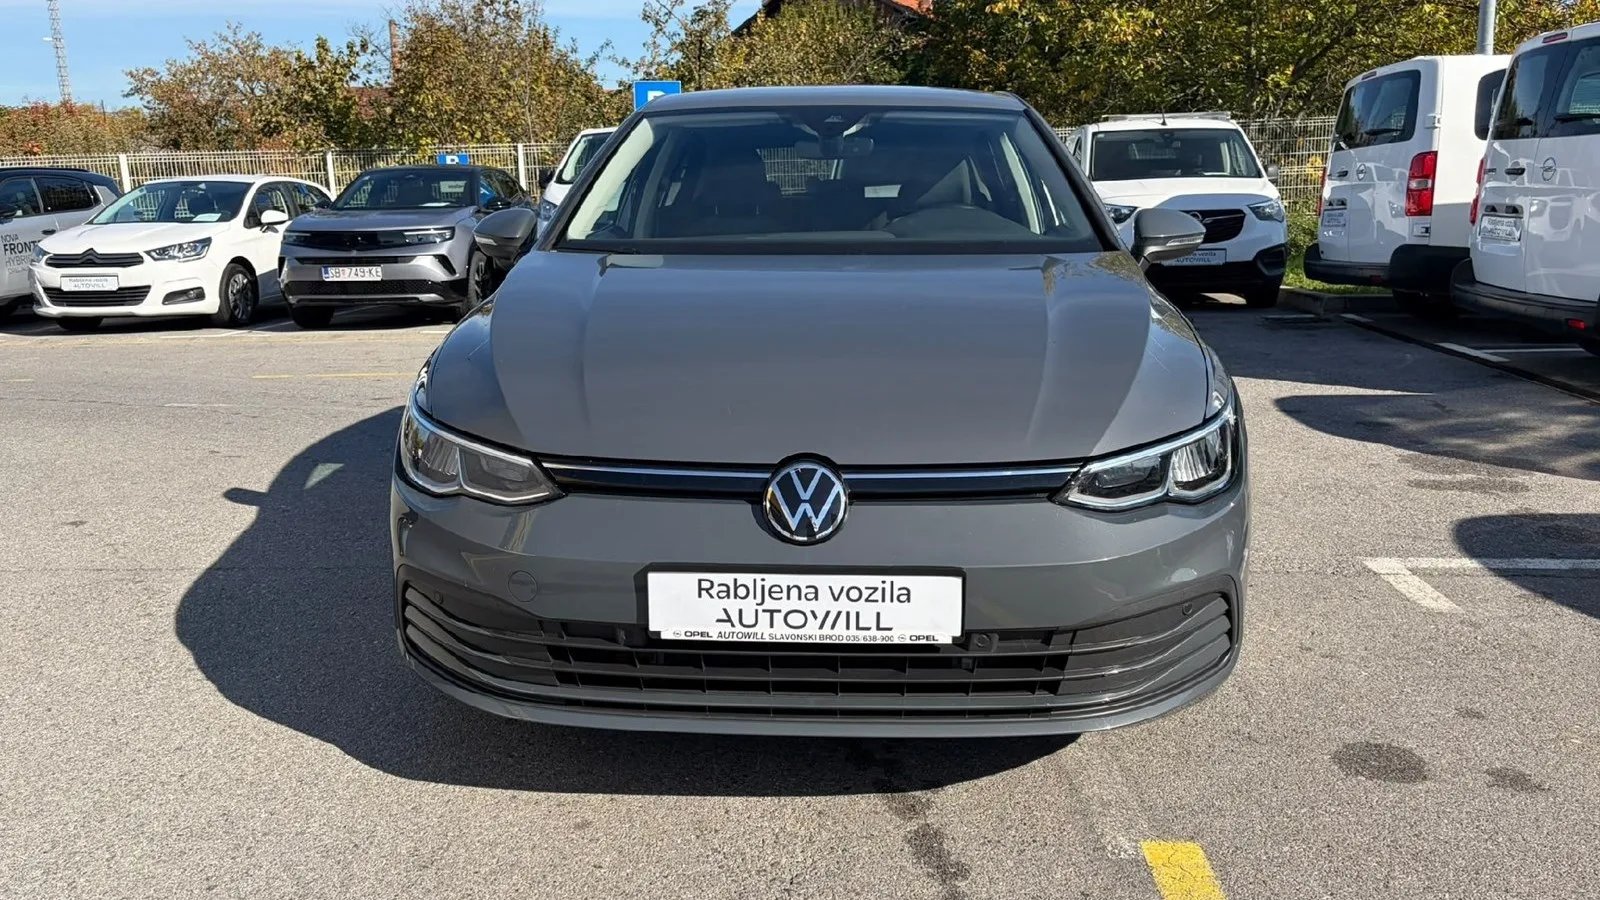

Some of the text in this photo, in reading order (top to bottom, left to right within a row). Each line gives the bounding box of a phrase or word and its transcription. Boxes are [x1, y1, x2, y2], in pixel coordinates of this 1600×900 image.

[1, 234, 19, 243] NOVA
[697, 578, 911, 606] Rabljena vozila
[715, 607, 893, 630] AUTOWILL
[684, 630, 713, 638] OPEL
[716, 631, 766, 640] AUTOWILL
[768, 633, 817, 641] SLAVONSKI
[819, 634, 844, 642] BROD
